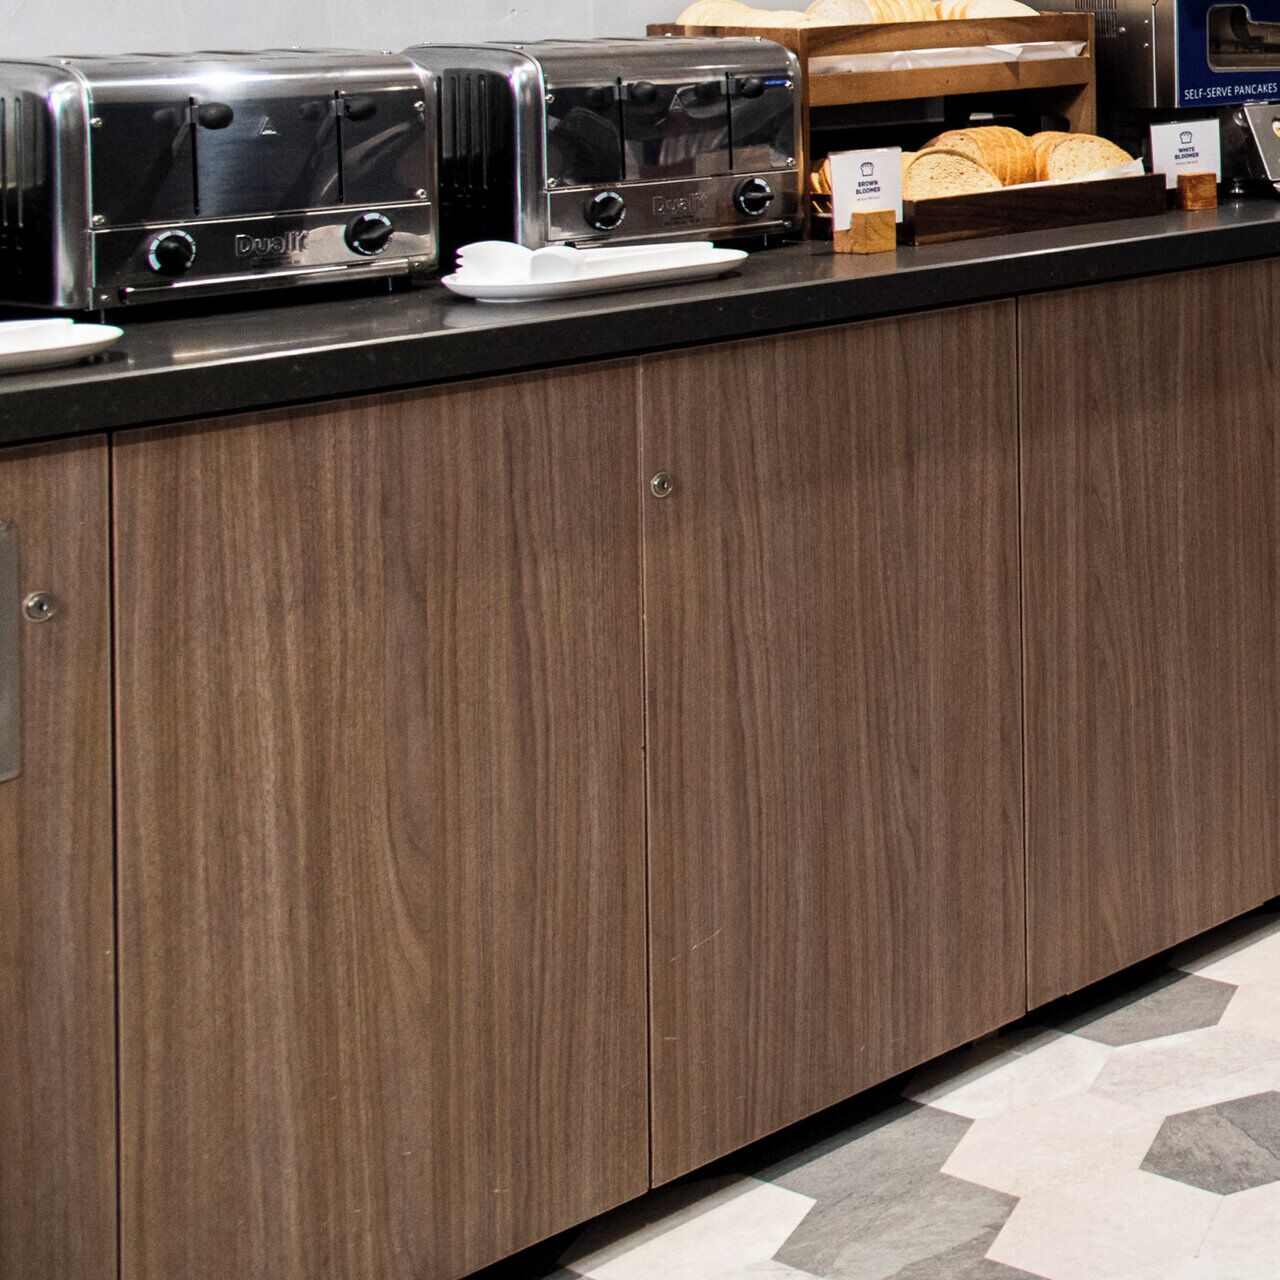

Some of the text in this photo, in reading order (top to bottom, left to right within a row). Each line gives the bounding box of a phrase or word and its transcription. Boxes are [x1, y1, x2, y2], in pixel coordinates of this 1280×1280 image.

[1184, 85, 1232, 100] SELF-SERVE
[1234, 82, 1278, 95] PANCAKES
[1174, 152, 1200, 160] BLOOMER
[857, 179, 879, 188] BROWN
[855, 186, 881, 195] BLOOMER
